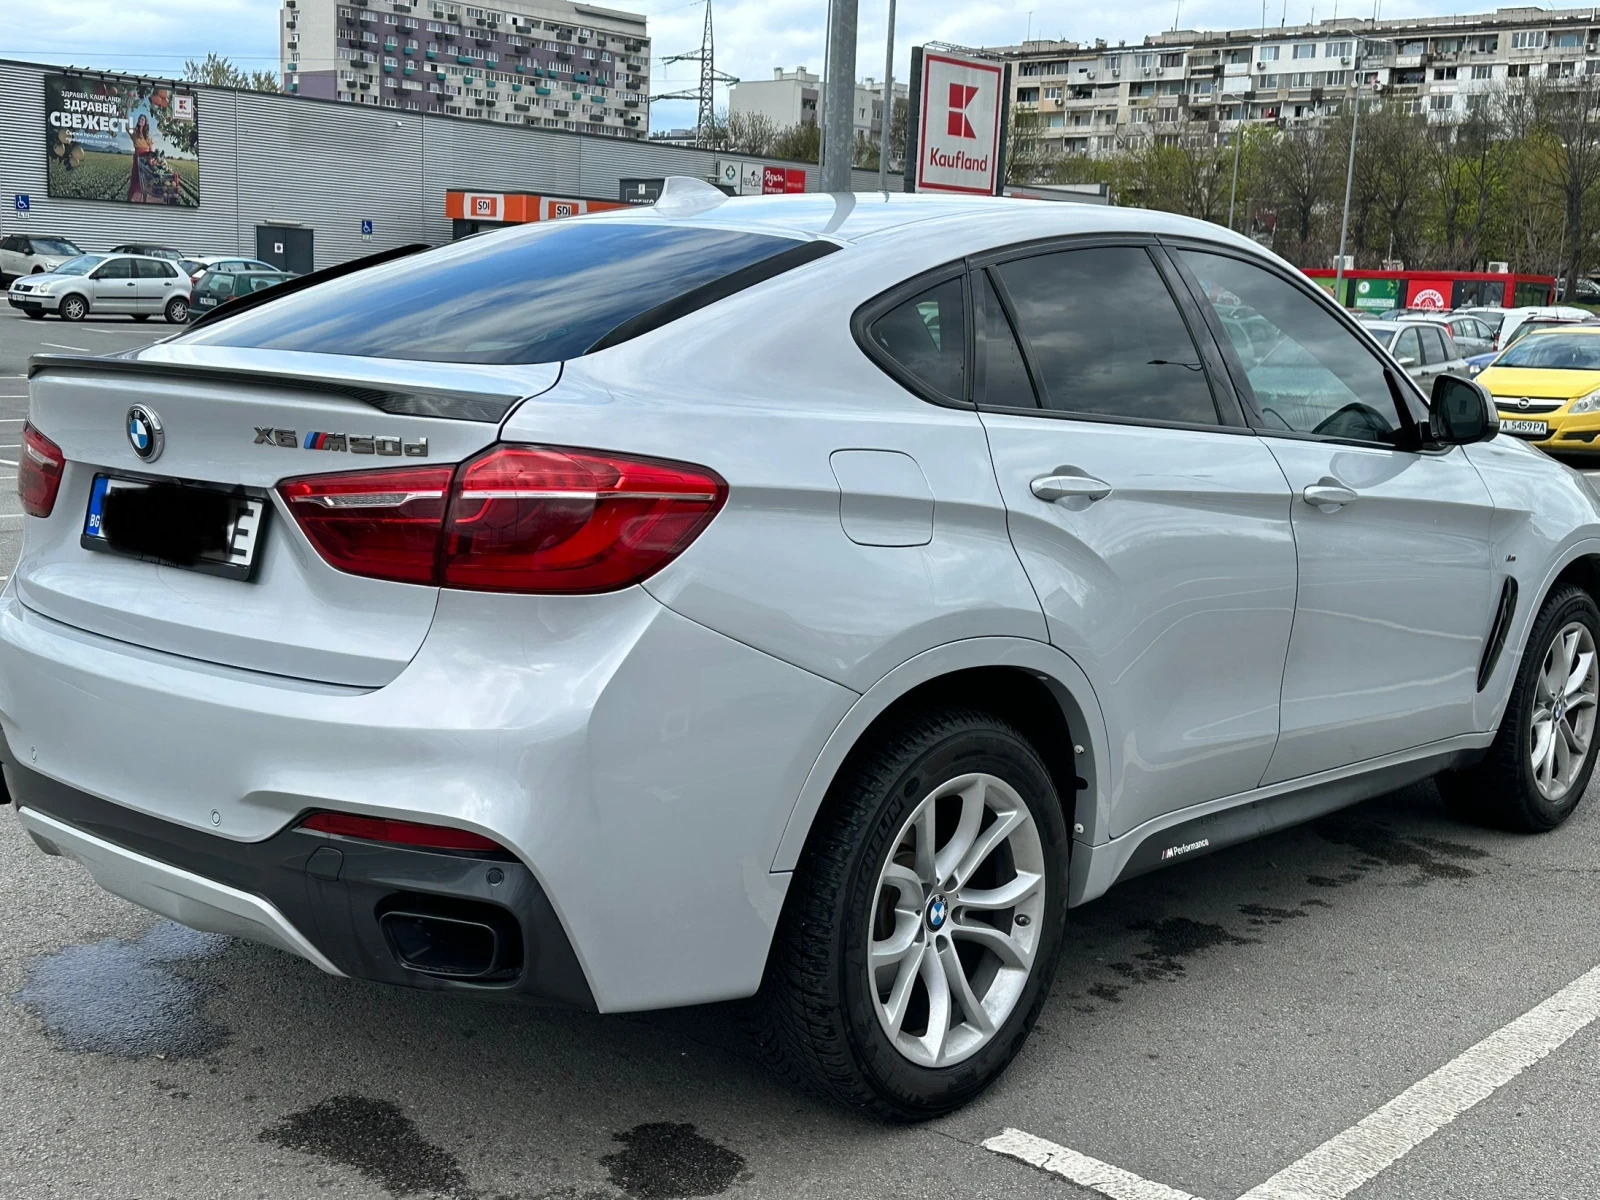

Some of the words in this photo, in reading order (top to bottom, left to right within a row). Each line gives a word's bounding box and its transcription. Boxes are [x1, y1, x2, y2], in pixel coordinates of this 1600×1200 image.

[63, 99, 119, 116] ЗДРАВЕЙ,
[50, 111, 134, 135] СВЕЖЕСТ!
[930, 147, 988, 172] Kaufland
[478, 201, 490, 211] SDI
[557, 205, 571, 216] SDI
[253, 426, 297, 448] X6
[89, 514, 101, 527] BG
[1173, 838, 1209, 856] Performance
